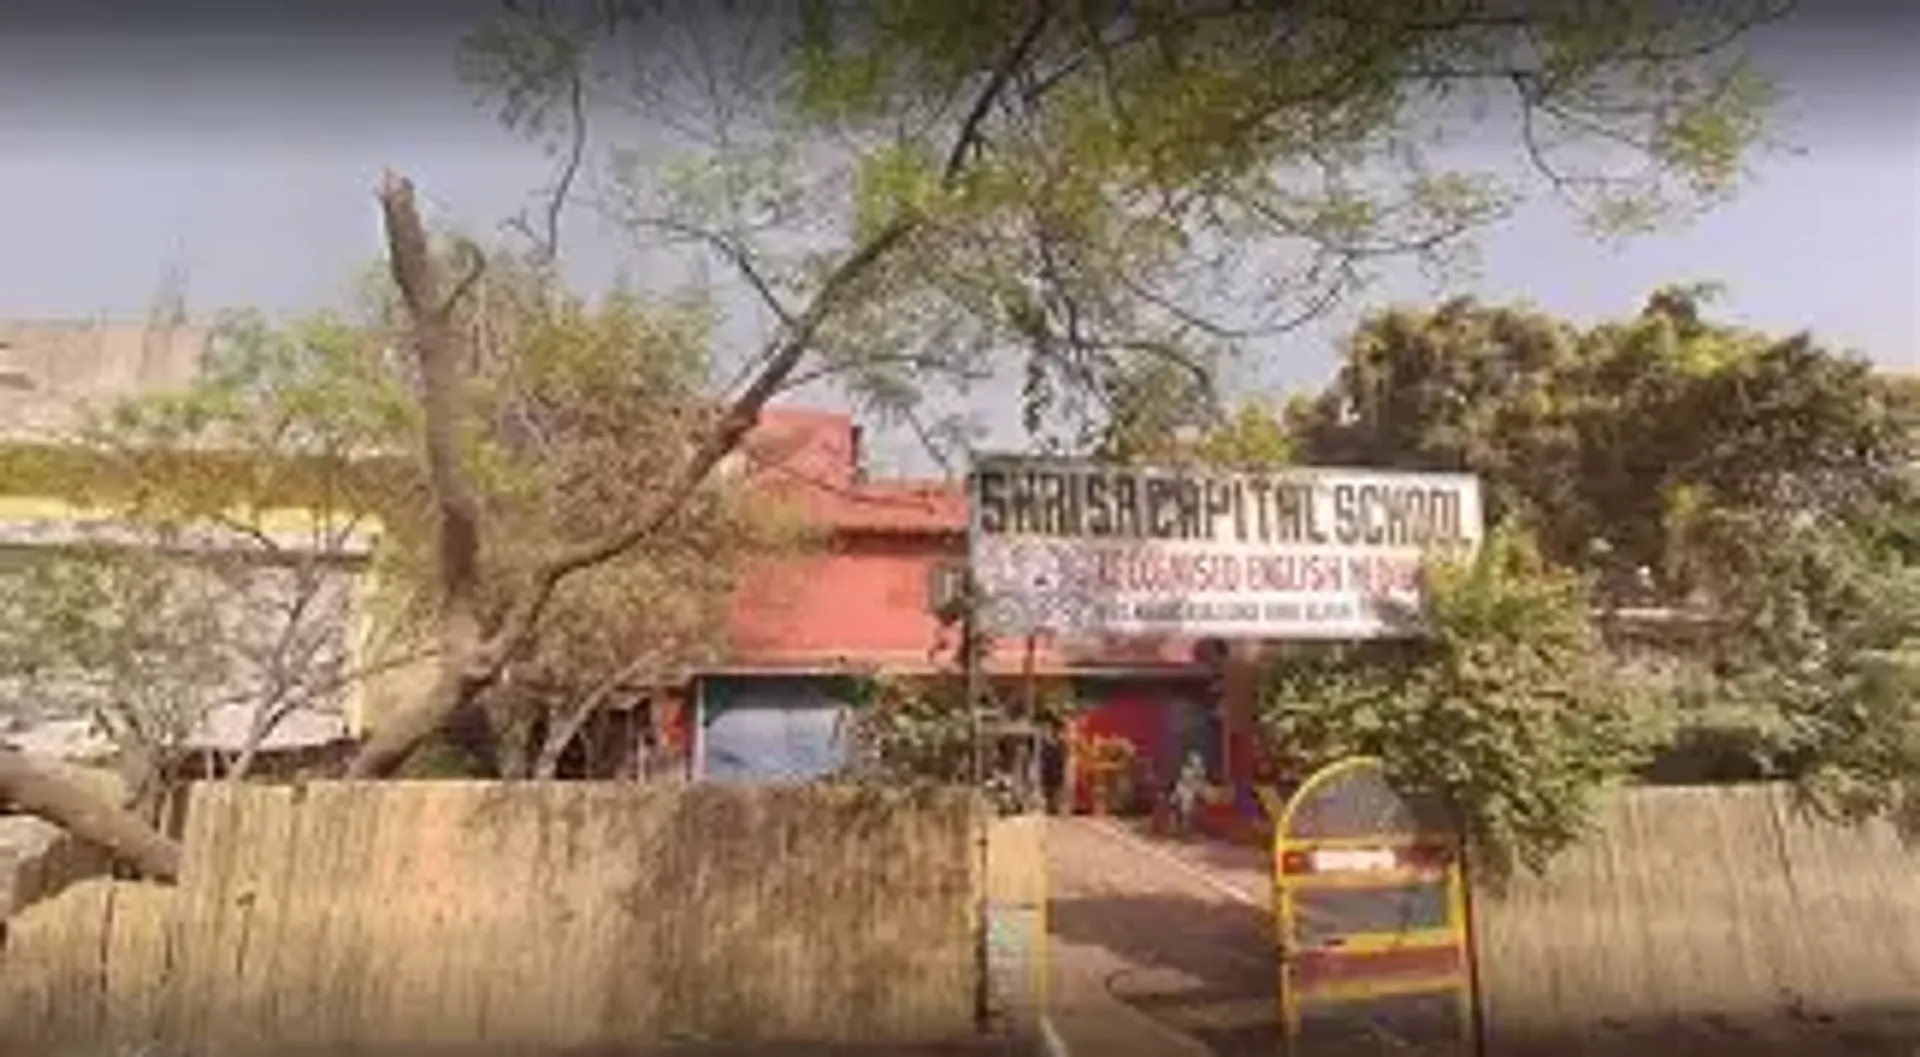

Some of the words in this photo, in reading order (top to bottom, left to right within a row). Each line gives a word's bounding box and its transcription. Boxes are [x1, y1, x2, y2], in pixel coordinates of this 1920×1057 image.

[1147, 477, 1327, 544] CAPITAL
[1334, 484, 1473, 546] SCHOOL
[1246, 555, 1343, 592] ENGLISH
